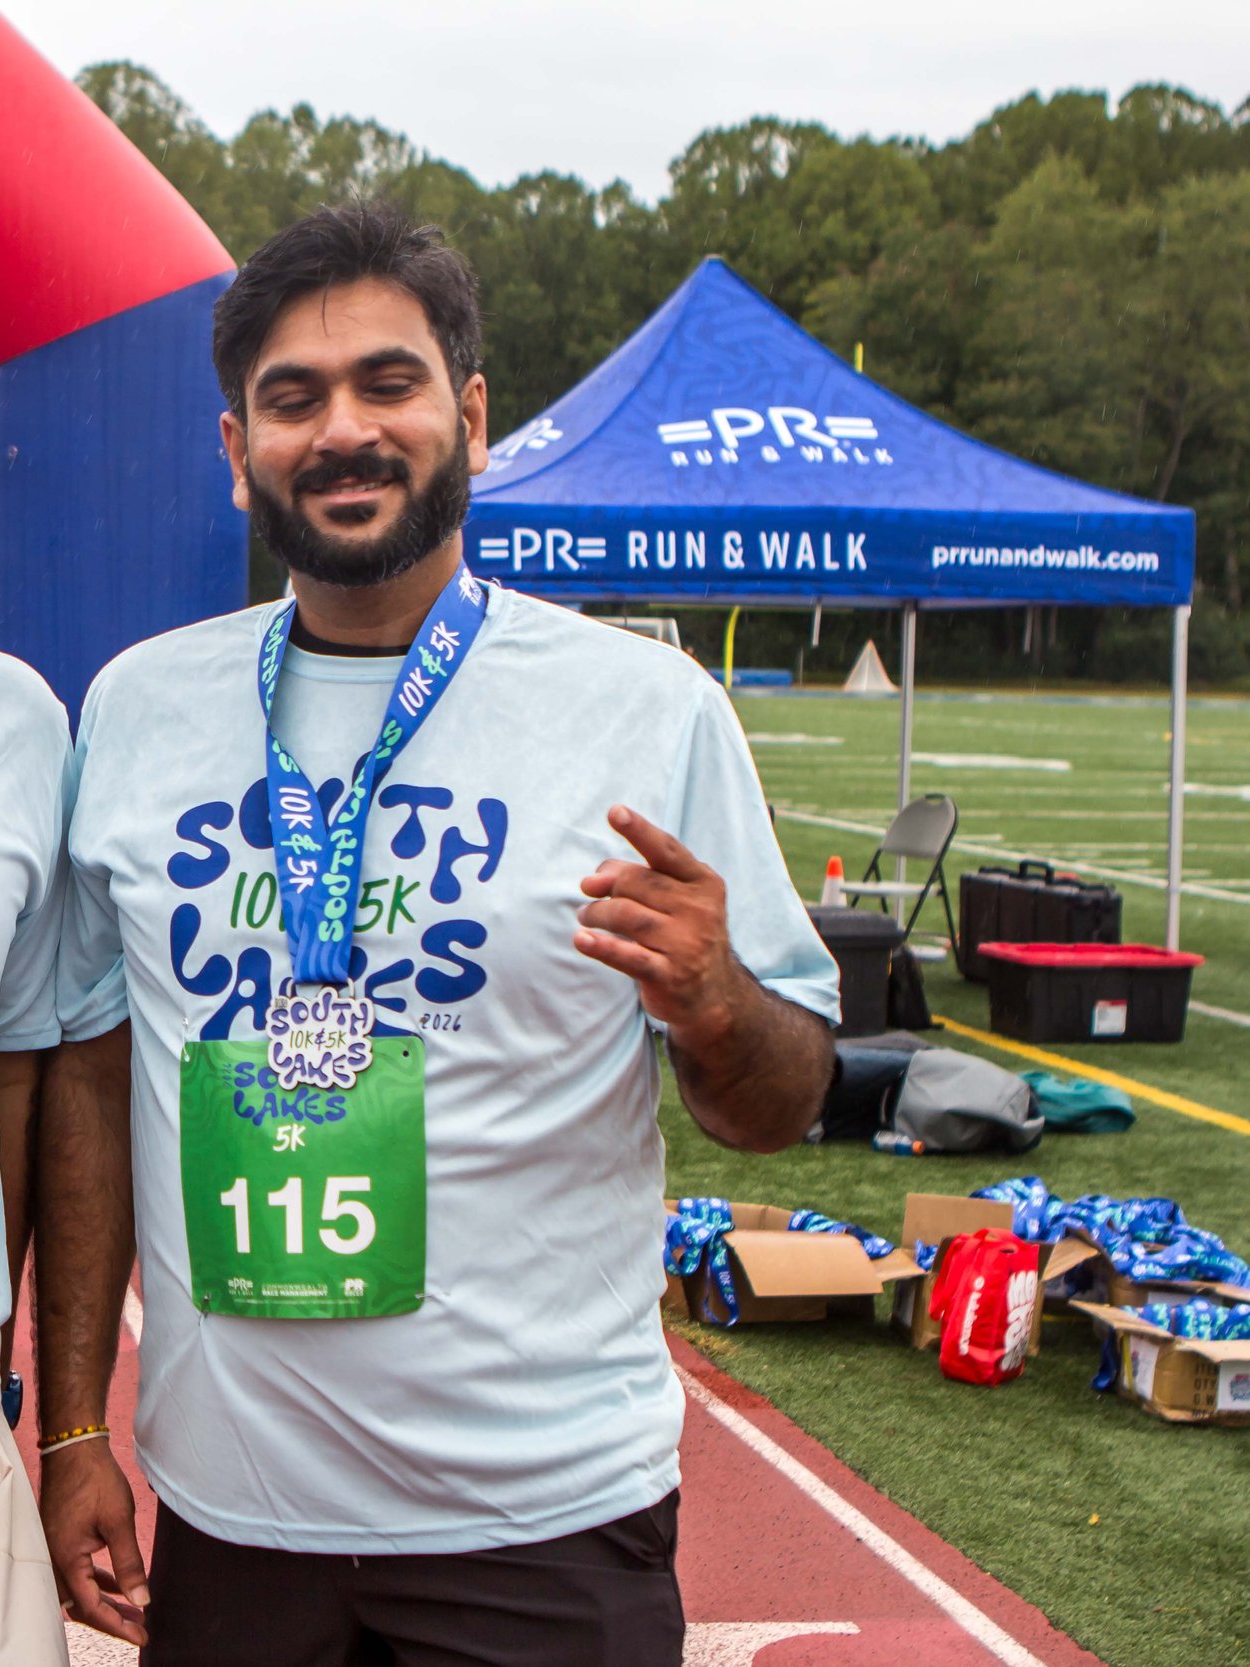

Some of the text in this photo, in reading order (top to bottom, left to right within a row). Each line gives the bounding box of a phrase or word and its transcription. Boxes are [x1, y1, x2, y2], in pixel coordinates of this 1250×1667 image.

[670, 449, 739, 467] RUN
[801, 445, 894, 465] WALK
[629, 531, 706, 569] RUN
[723, 531, 745, 569] &
[760, 531, 868, 571] WALK
[932, 544, 1159, 572] prrunandwalk.com
[399, 621, 461, 717] 10K & 5K
[278, 787, 314, 830] 10K
[280, 832, 323, 856] &
[286, 856, 318, 895] 5K
[353, 874, 421, 935] 5K
[271, 991, 368, 1036] SOUTH
[421, 1013, 462, 1031] 2026
[272, 1042, 367, 1084] LAKES
[233, 1087, 347, 1127] LAKES
[272, 1123, 307, 1152] 5K
[220, 1176, 377, 1255] 115
